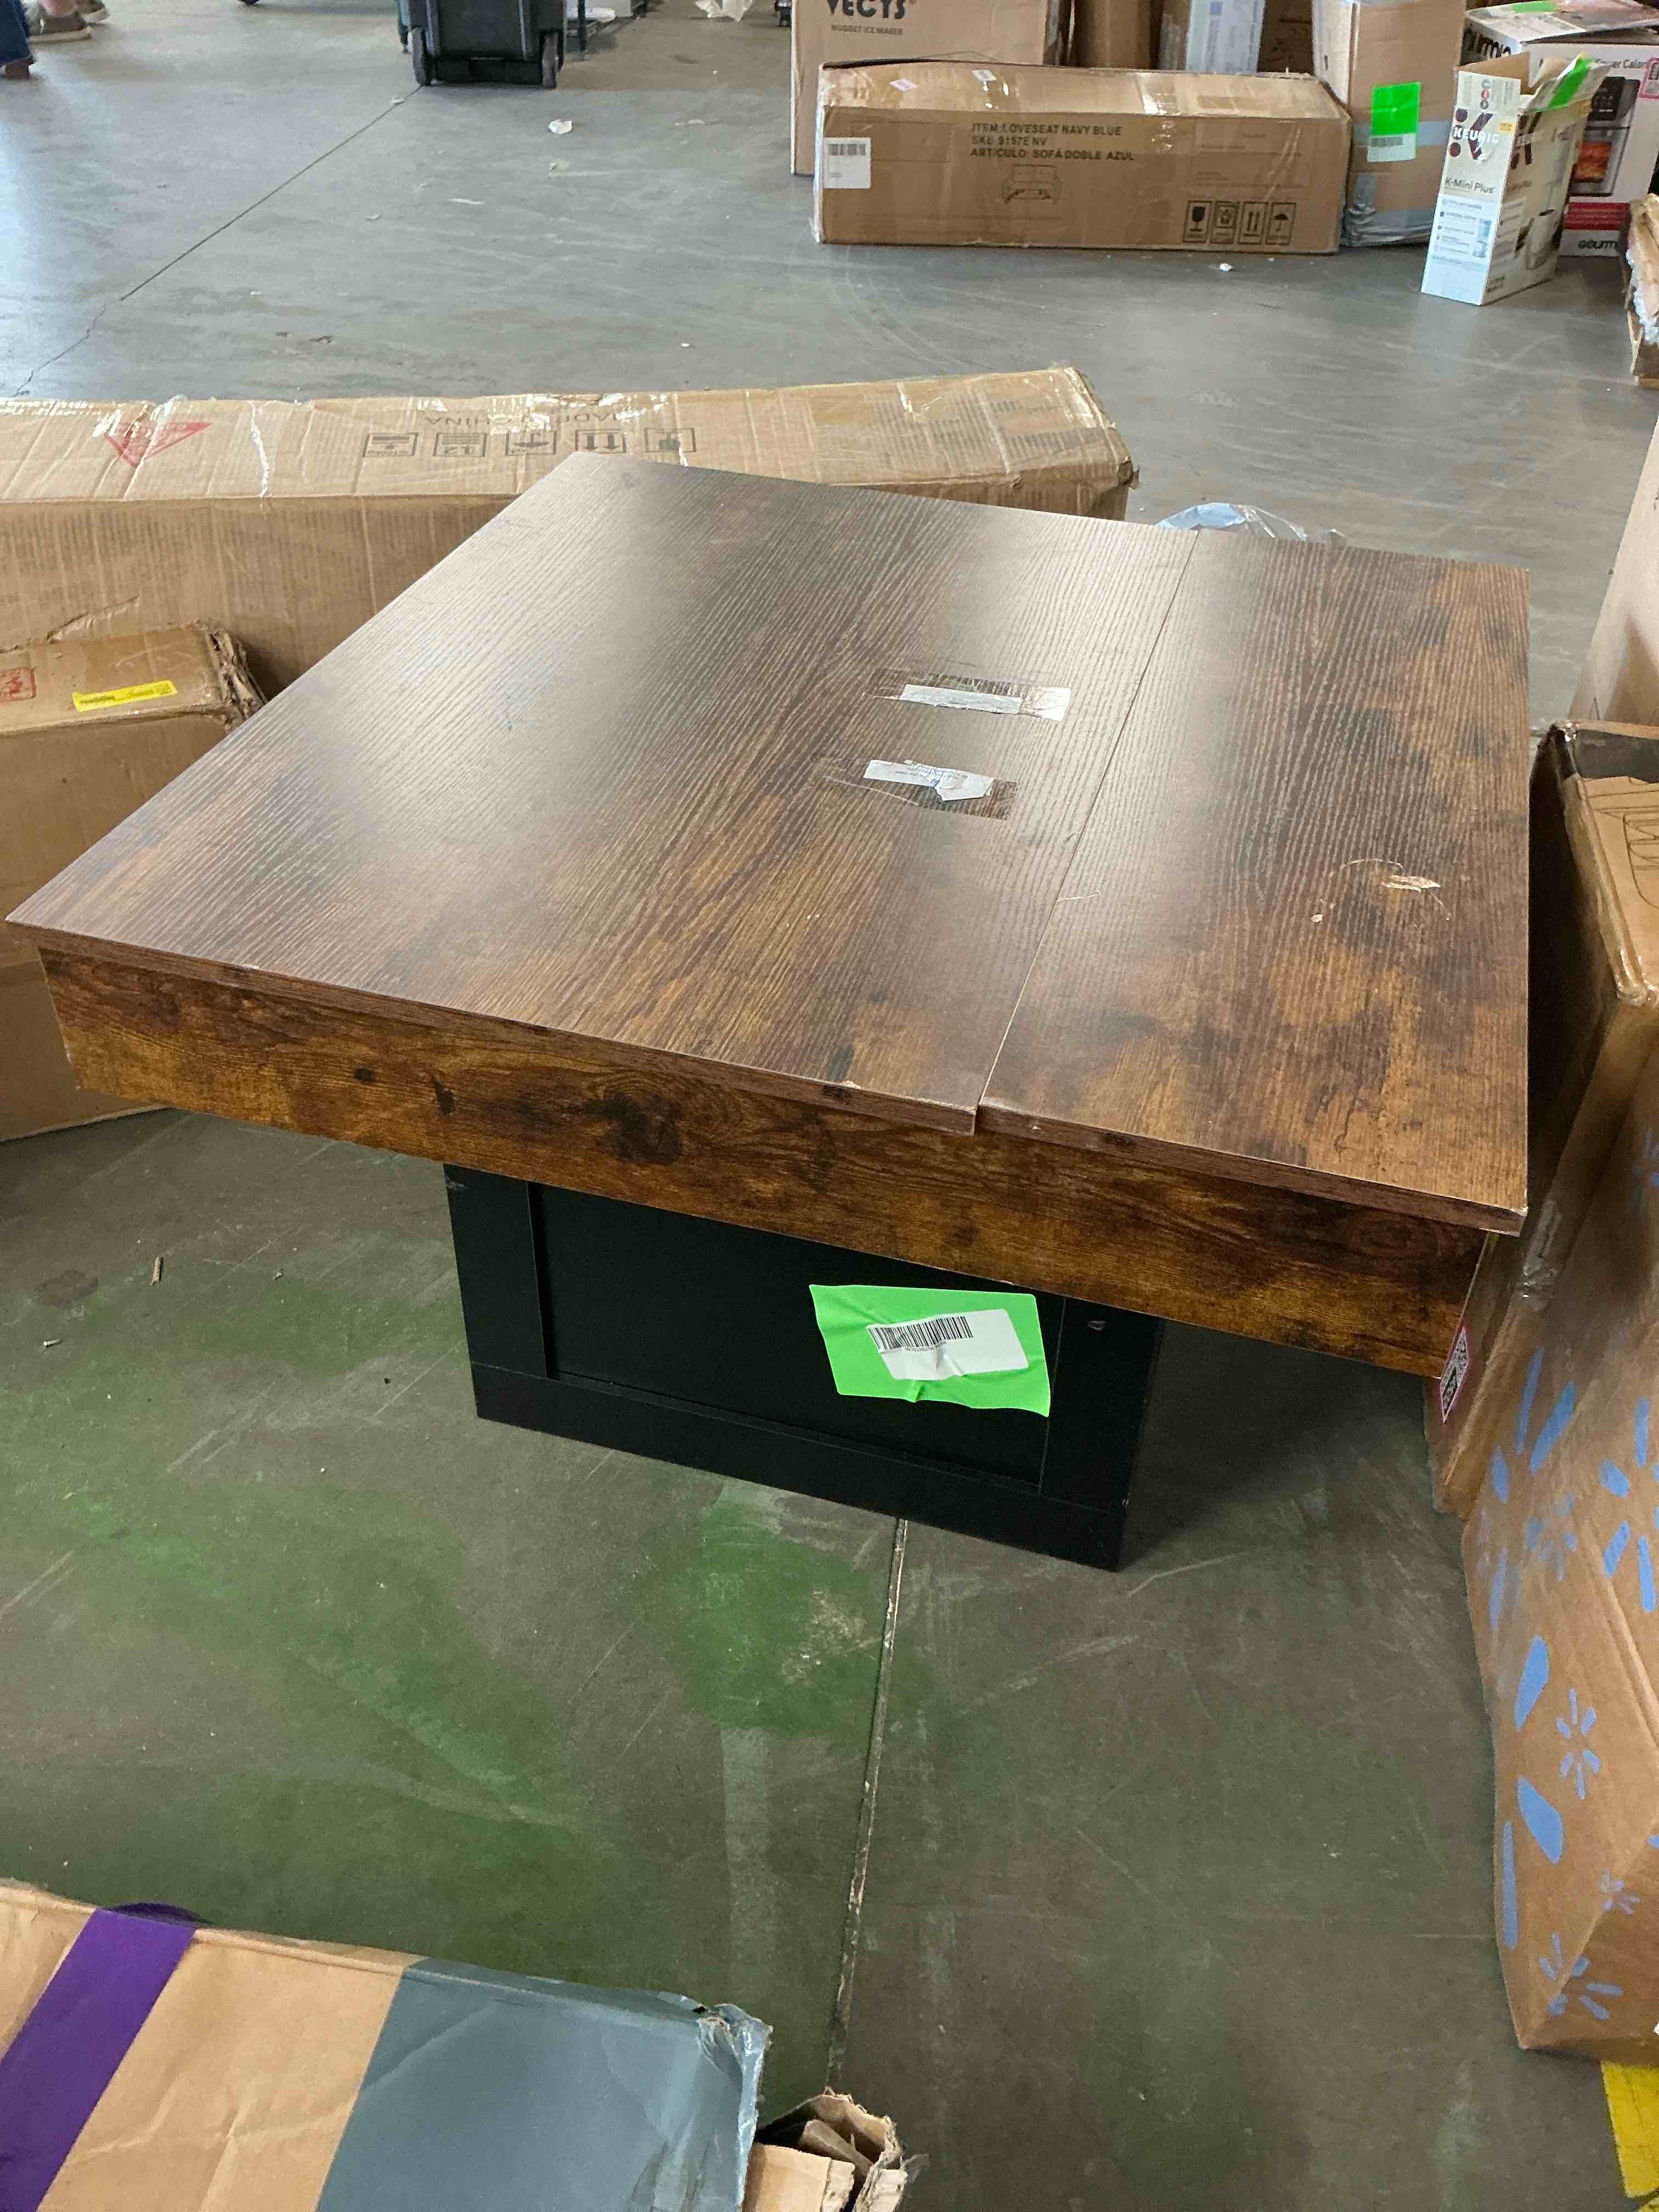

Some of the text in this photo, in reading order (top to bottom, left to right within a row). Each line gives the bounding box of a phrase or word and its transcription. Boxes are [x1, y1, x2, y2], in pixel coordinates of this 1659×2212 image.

[1002, 123, 1059, 134] LOVESEAT
[1062, 125, 1091, 135] NAVY
[1092, 125, 1123, 136] BLUE
[1106, 150, 1135, 161] AZUL
[1444, 177, 1474, 190] K-Mini
